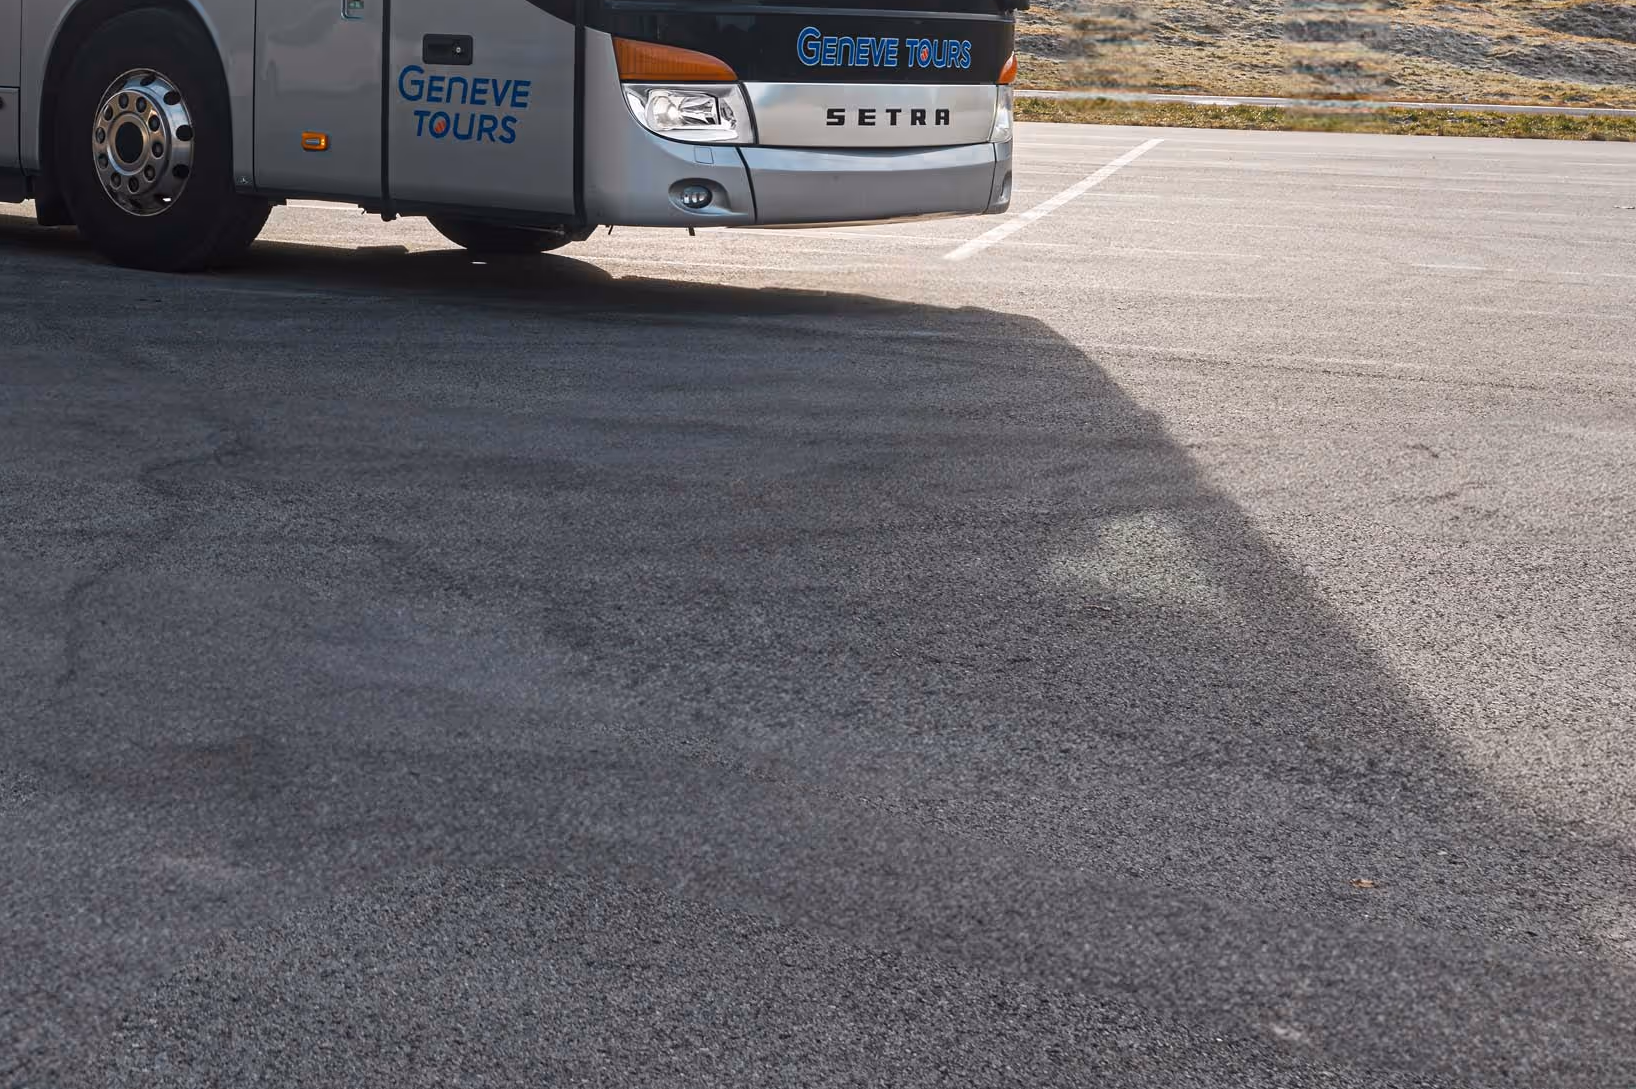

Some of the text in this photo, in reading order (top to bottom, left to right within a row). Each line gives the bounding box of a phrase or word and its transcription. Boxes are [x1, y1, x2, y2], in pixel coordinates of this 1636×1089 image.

[905, 38, 972, 69] TOURS
[413, 110, 518, 144] TOURS
[826, 108, 950, 126] SETRA
